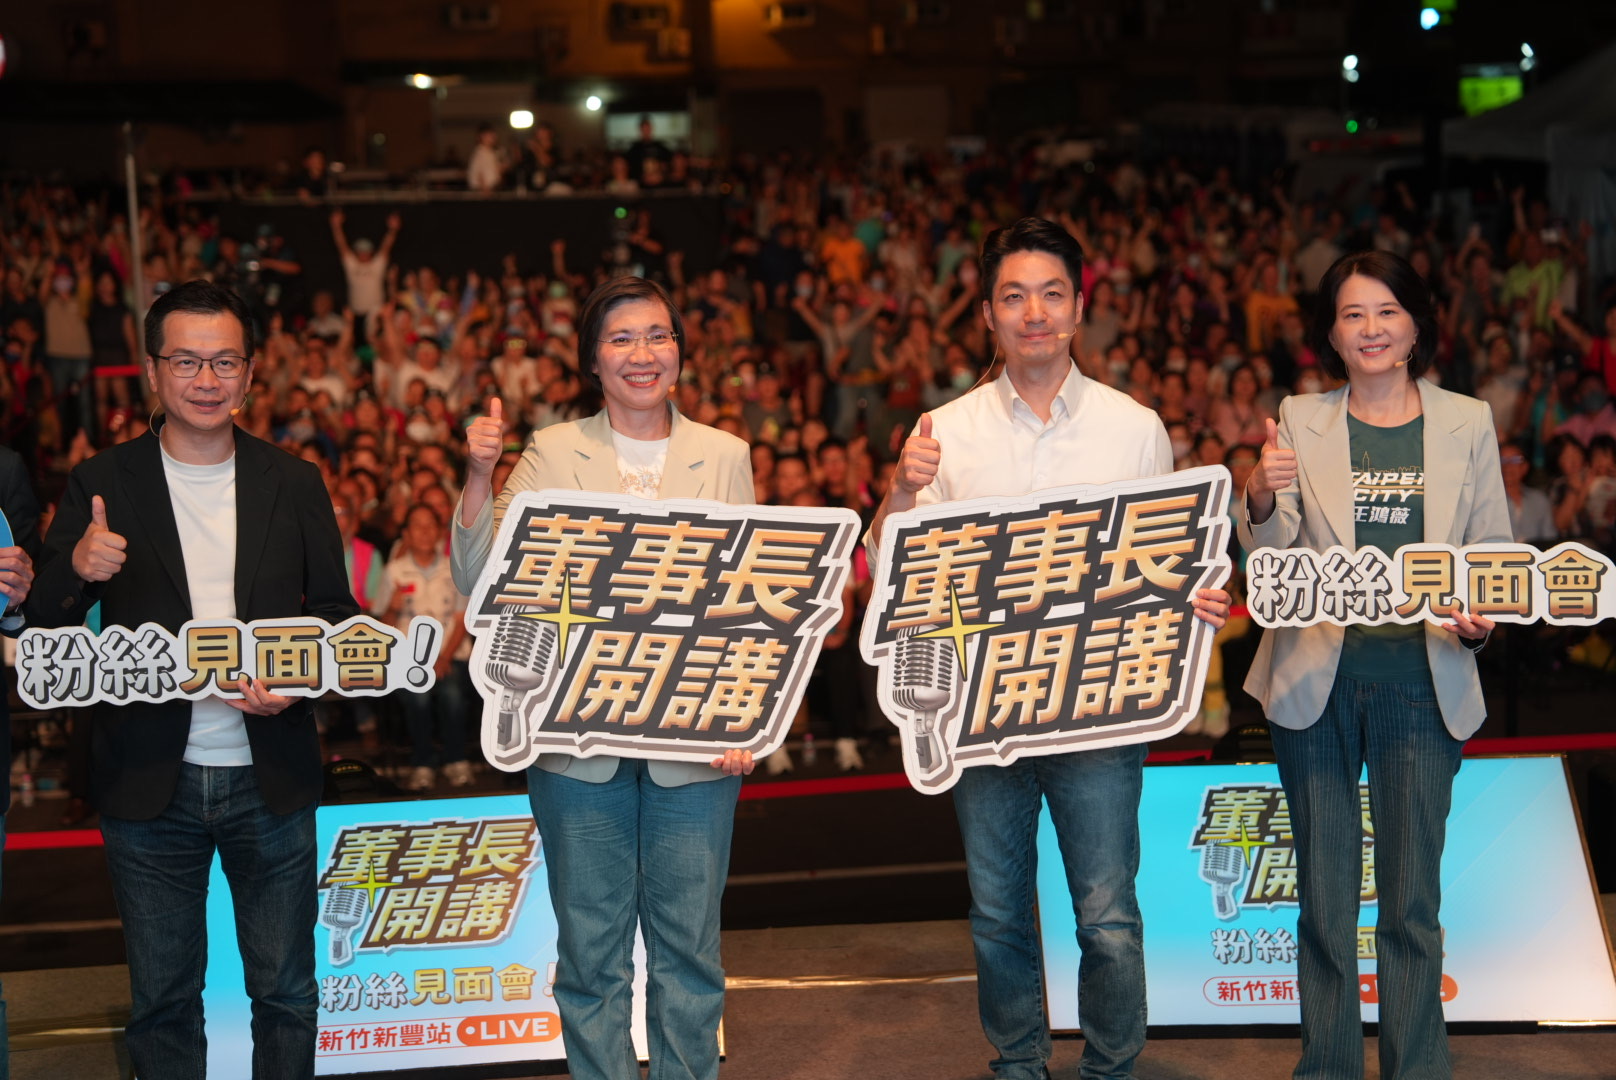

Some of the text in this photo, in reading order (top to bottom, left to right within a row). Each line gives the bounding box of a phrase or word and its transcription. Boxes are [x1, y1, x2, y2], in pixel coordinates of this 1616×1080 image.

[1354, 488, 1415, 502] CITY
[1354, 505, 1411, 524] 王鴻薇
[493, 513, 826, 624] 董事長
[886, 492, 1199, 631] 董事長
[1252, 549, 1608, 622] 粉絲見面會
[22, 622, 435, 702] 粉絲見面會!
[554, 630, 789, 732] 開講
[969, 608, 1185, 735] 開講
[325, 822, 532, 883] 董事長
[368, 881, 516, 943] 開講
[321, 962, 556, 1012] 粉絲見面會!
[318, 1022, 451, 1051] 新竹新豐站
[480, 1017, 550, 1040] LIVE
